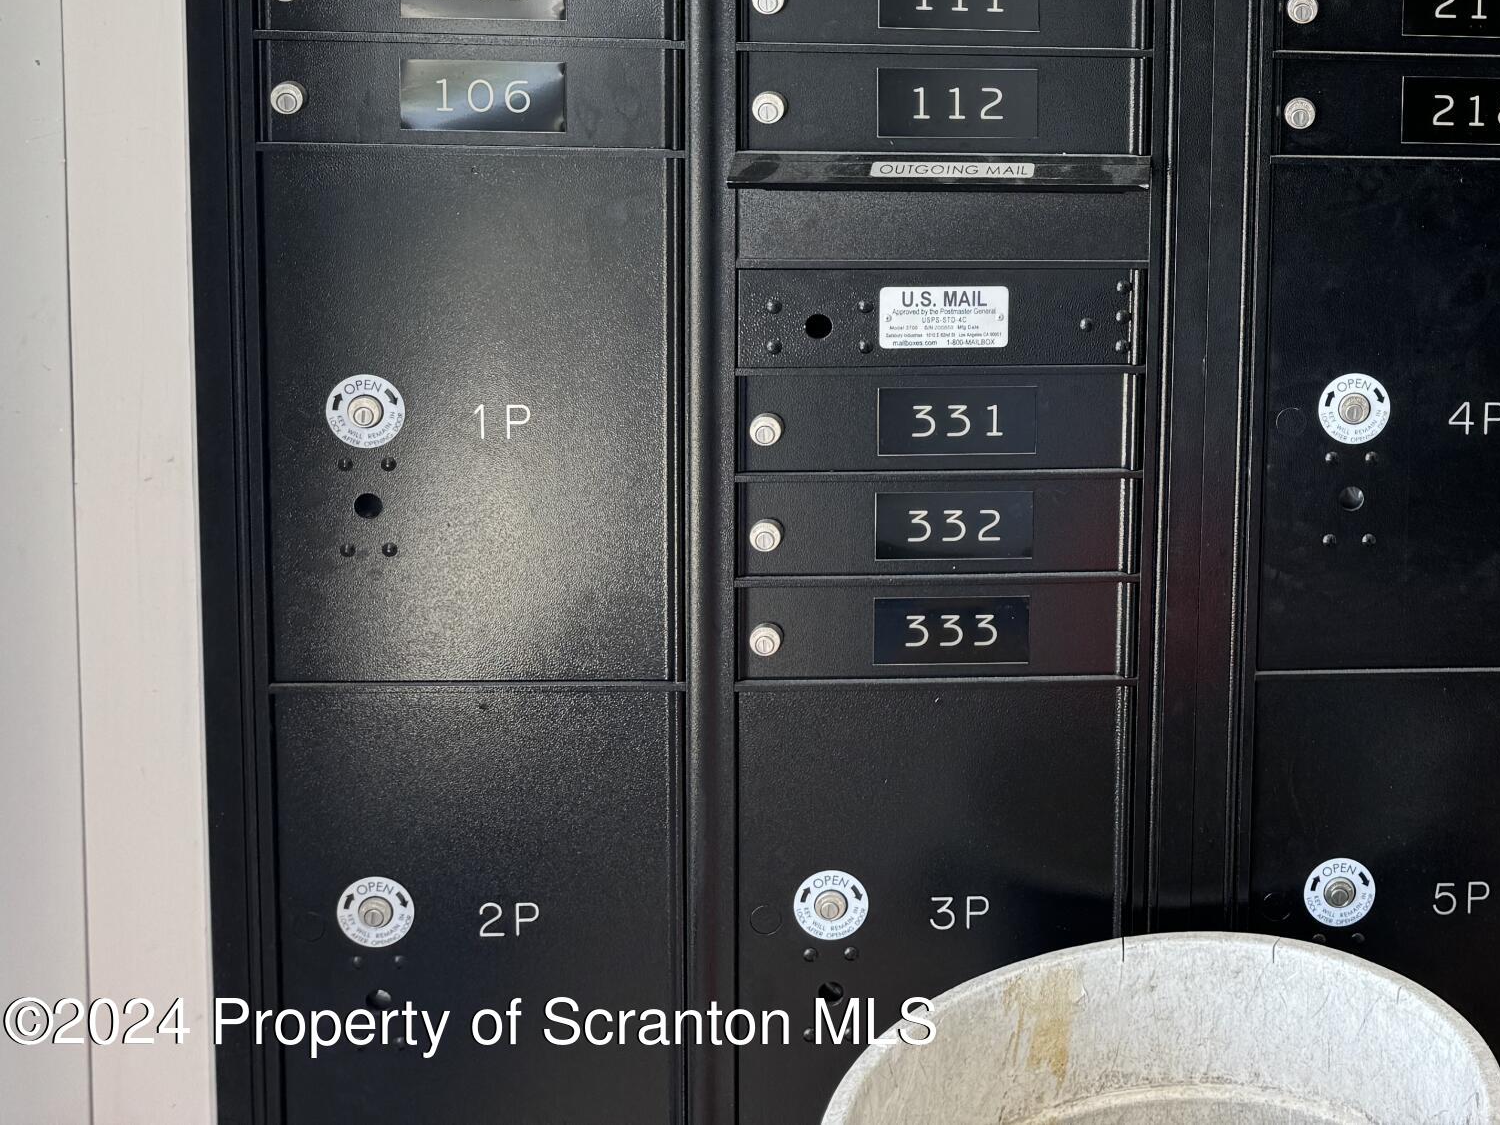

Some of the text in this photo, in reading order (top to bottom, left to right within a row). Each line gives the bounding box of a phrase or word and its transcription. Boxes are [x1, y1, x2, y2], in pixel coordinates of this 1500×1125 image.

[436, 78, 531, 114] 106
[913, 86, 1004, 120] 112
[880, 164, 1028, 175] OUTGOING MAIL
[902, 291, 987, 307] U.S. MAIL
[344, 380, 382, 394] OPEN
[1337, 379, 1371, 392] OPEN
[473, 403, 531, 440] 1P
[911, 404, 1004, 438] 331
[907, 509, 1001, 543] 332
[905, 614, 998, 647] 333
[813, 875, 849, 888] OPEN
[1323, 863, 1357, 876] OPEN
[357, 882, 394, 895] OPEN
[1432, 881, 1490, 916] 5P
[479, 902, 540, 938] 2P
[929, 895, 990, 930] 3P
